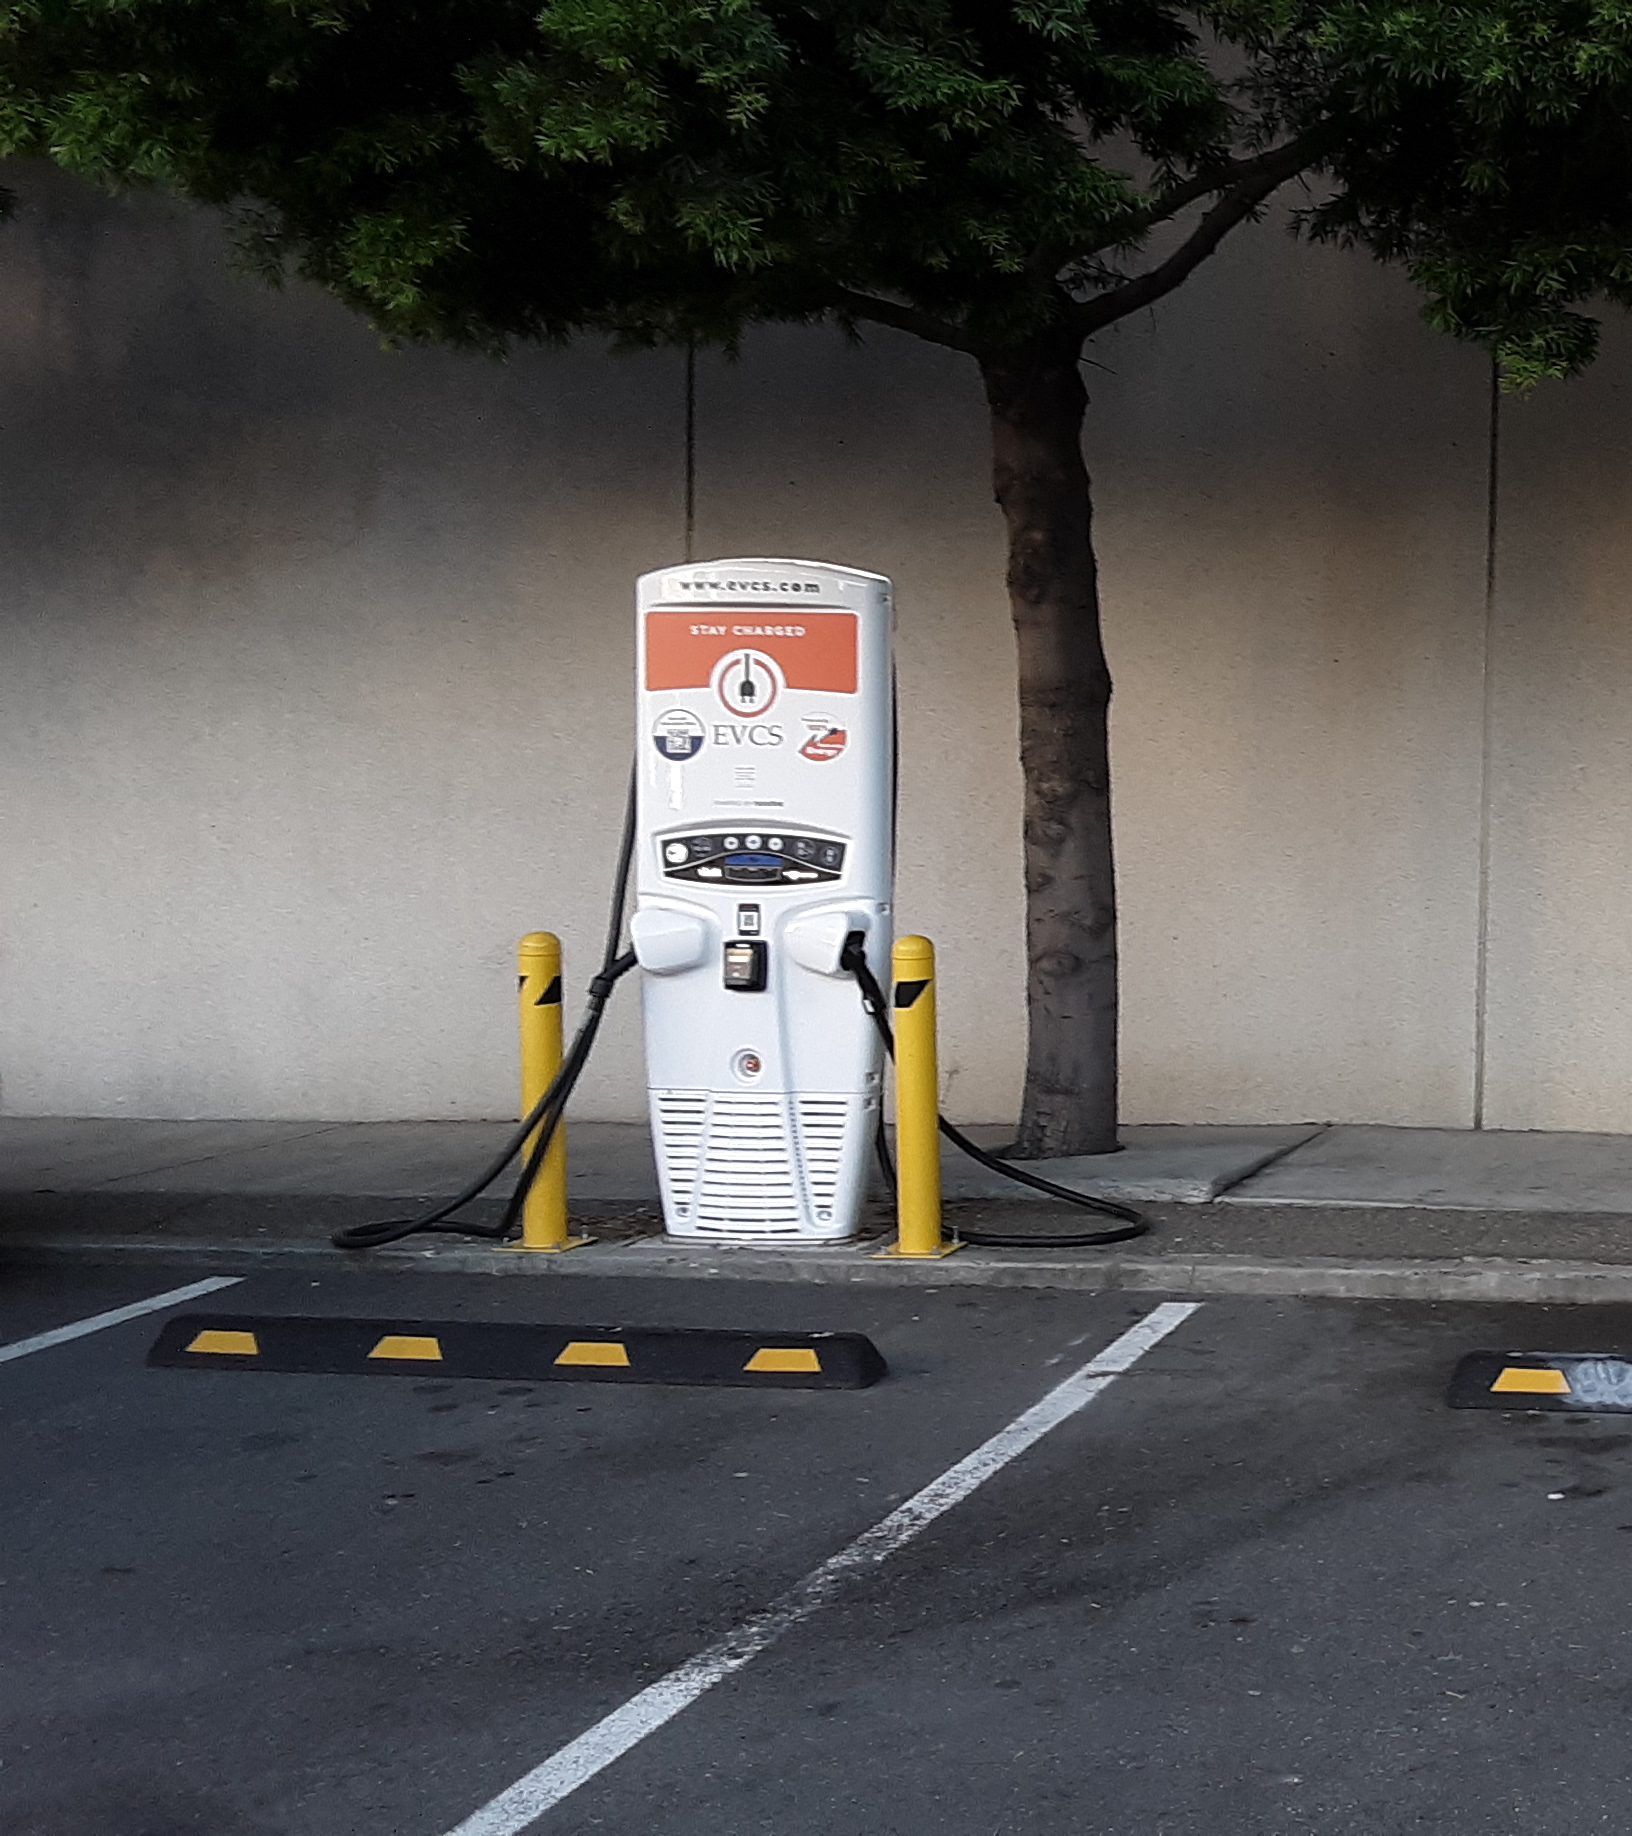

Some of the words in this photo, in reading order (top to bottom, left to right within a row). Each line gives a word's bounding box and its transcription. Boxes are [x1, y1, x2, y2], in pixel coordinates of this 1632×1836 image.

[678, 580, 820, 594] www.evcs.com
[689, 625, 727, 636] STAY
[732, 625, 806, 637] CHARGED
[712, 724, 784, 746] EVCS
